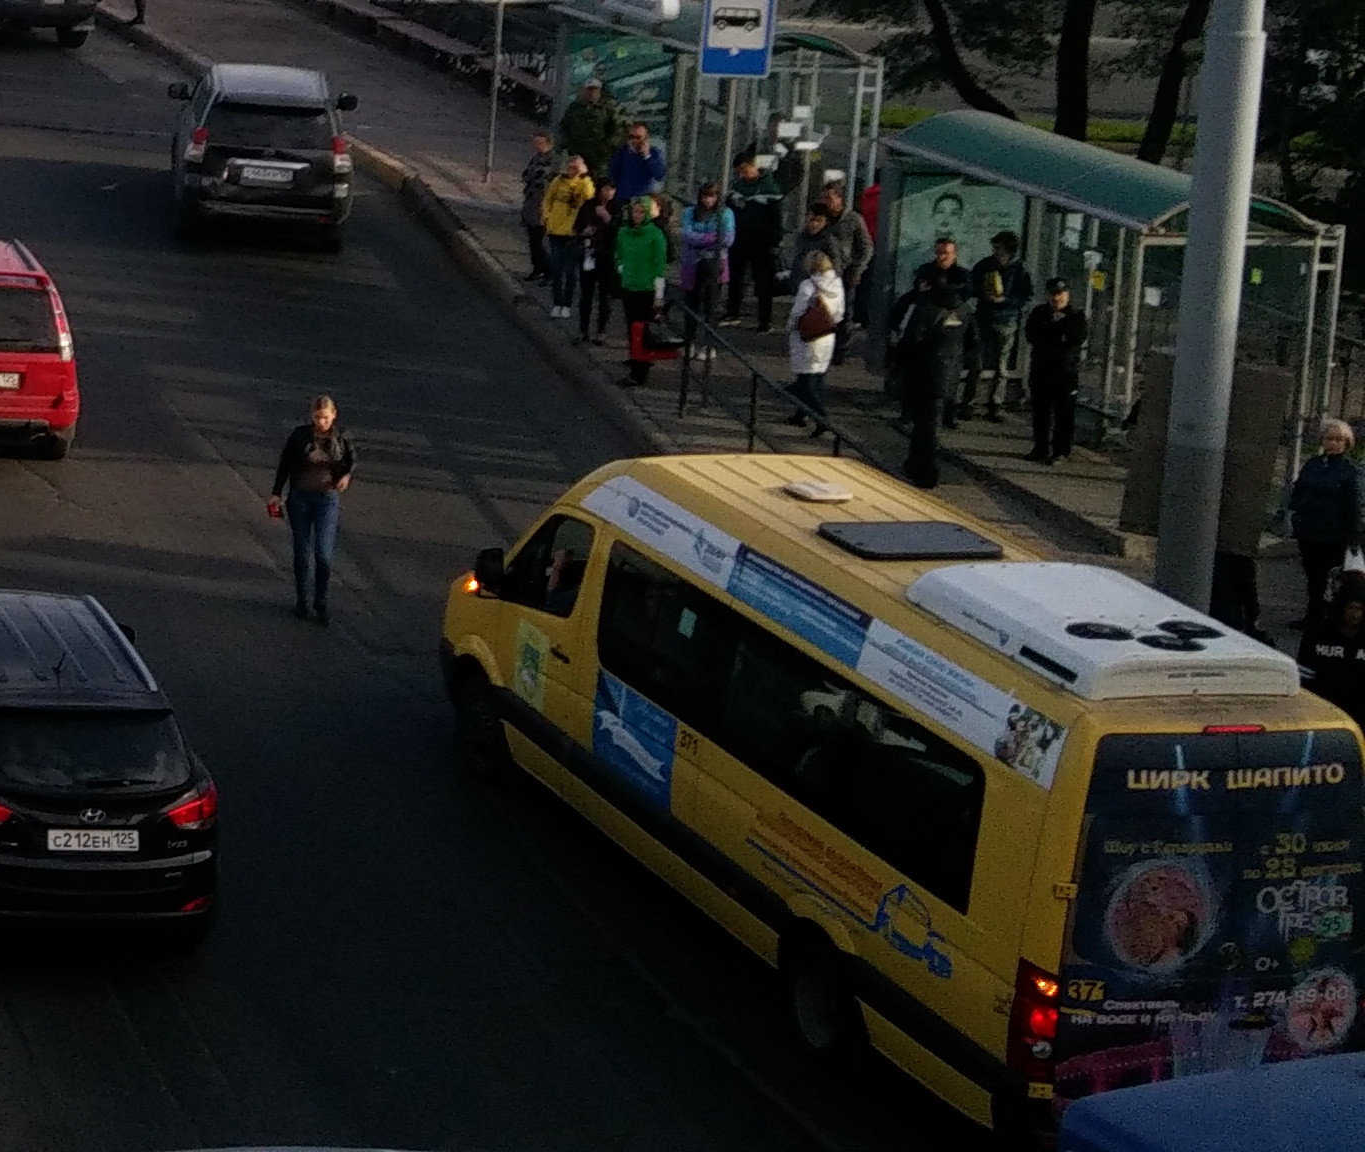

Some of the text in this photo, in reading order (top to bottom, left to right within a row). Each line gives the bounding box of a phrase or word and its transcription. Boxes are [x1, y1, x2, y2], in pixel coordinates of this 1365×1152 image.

[1127, 762, 1345, 791] ЦИРК ШАПИТО
[52, 831, 136, 849] С212ЕН 125
